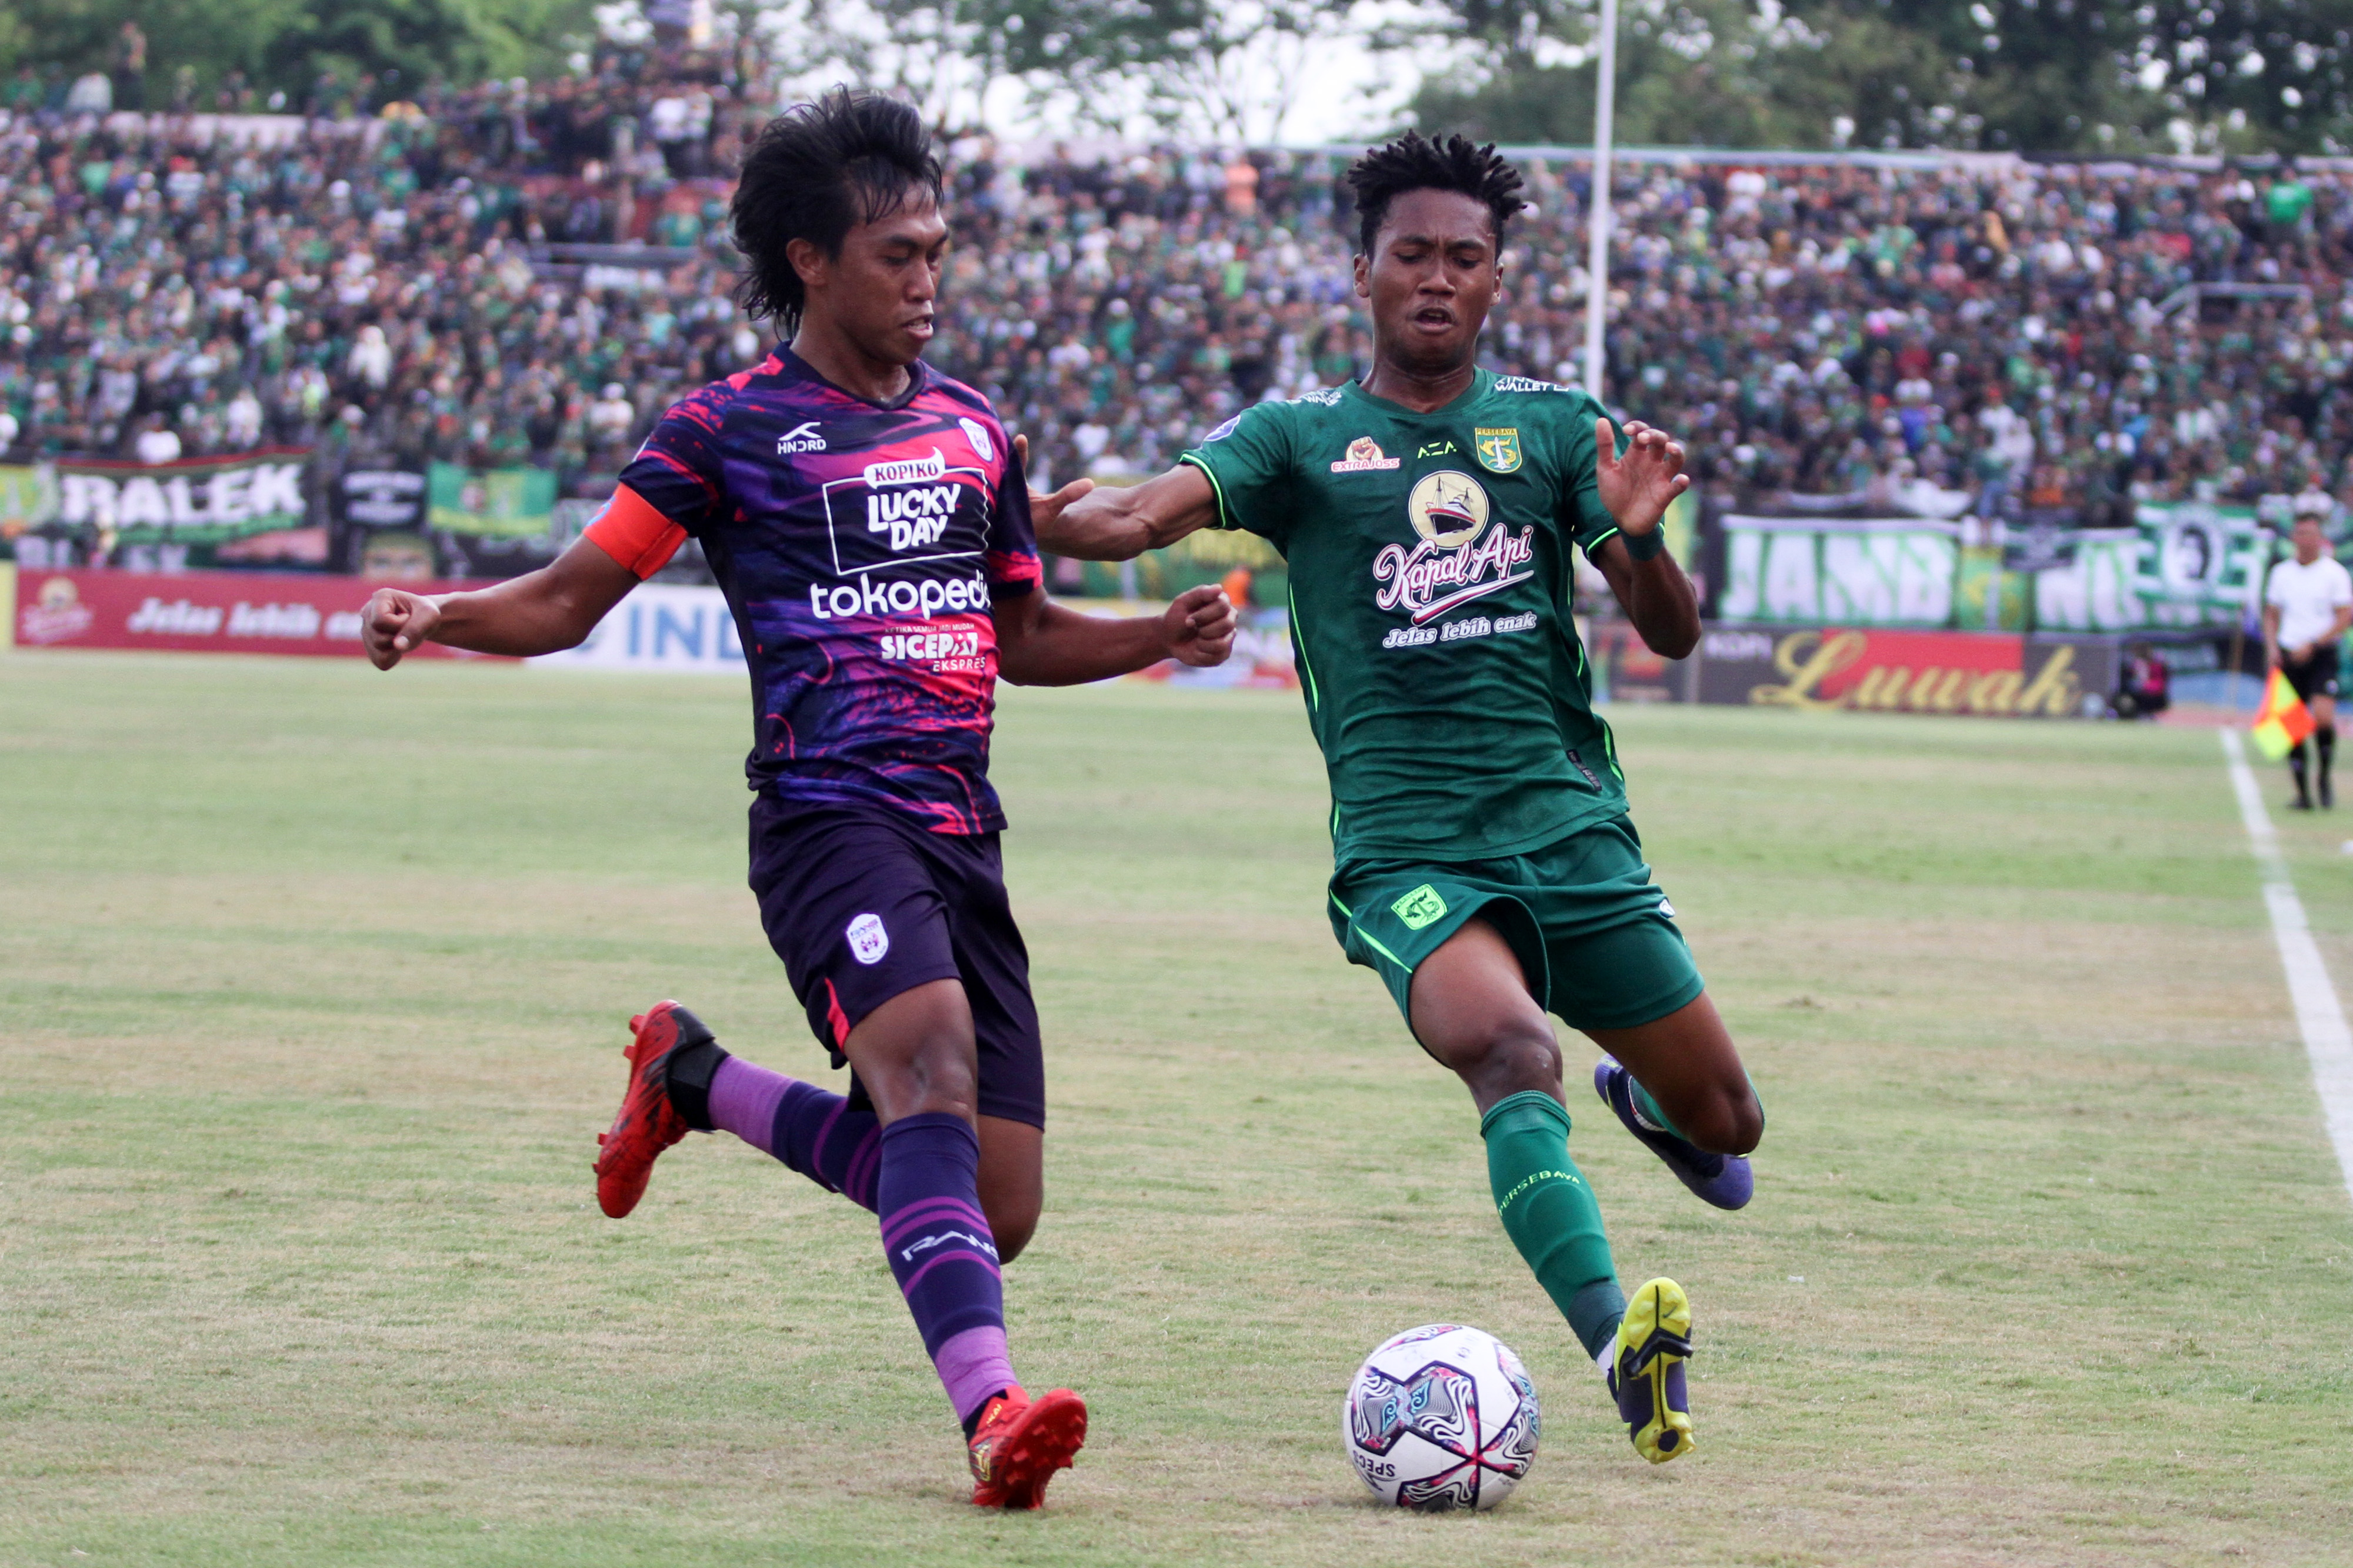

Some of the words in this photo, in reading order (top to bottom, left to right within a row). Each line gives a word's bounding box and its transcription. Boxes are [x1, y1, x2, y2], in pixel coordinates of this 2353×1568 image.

[1494, 382, 1551, 392] WALLET
[874, 462, 938, 482] KOPIKO
[867, 483, 961, 532] LUCKY
[890, 515, 948, 551] DAY
[1373, 539, 1472, 610] Kapal
[1469, 522, 1534, 581] Api
[881, 632, 978, 660] SICEPAT
[1383, 628, 1436, 648] Jelas
[1441, 618, 1490, 642] lebih
[1494, 611, 1536, 631] enak
[932, 657, 986, 672] EKSPRES
[1747, 629, 2082, 714] Luwak
